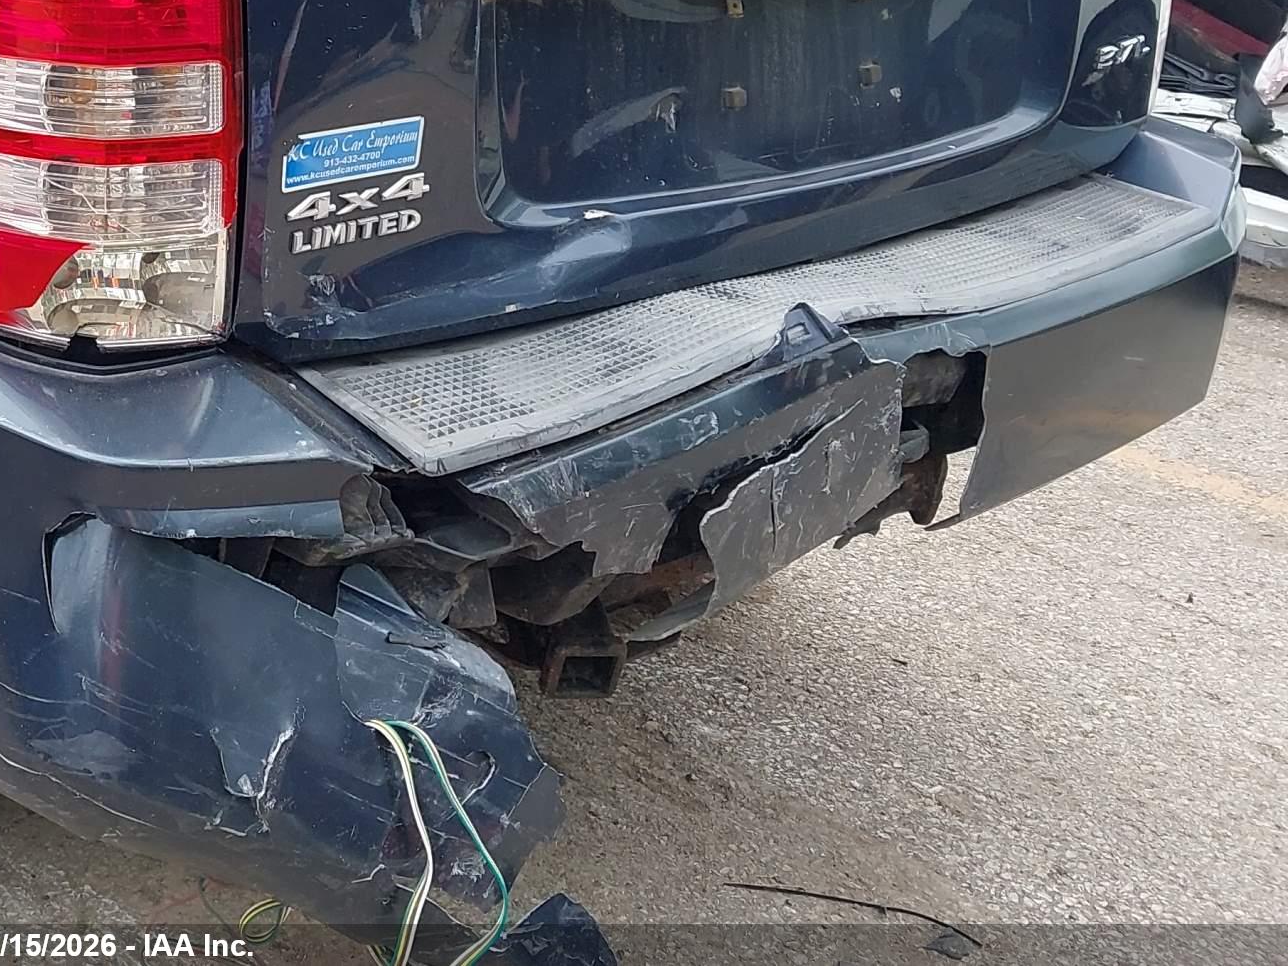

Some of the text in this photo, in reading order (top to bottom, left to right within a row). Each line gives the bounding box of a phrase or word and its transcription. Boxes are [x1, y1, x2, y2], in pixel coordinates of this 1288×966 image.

[287, 129, 419, 163] KC Used Car Emporium
[323, 150, 381, 168] 913-432-4700
[291, 208, 423, 255] LIMITED
